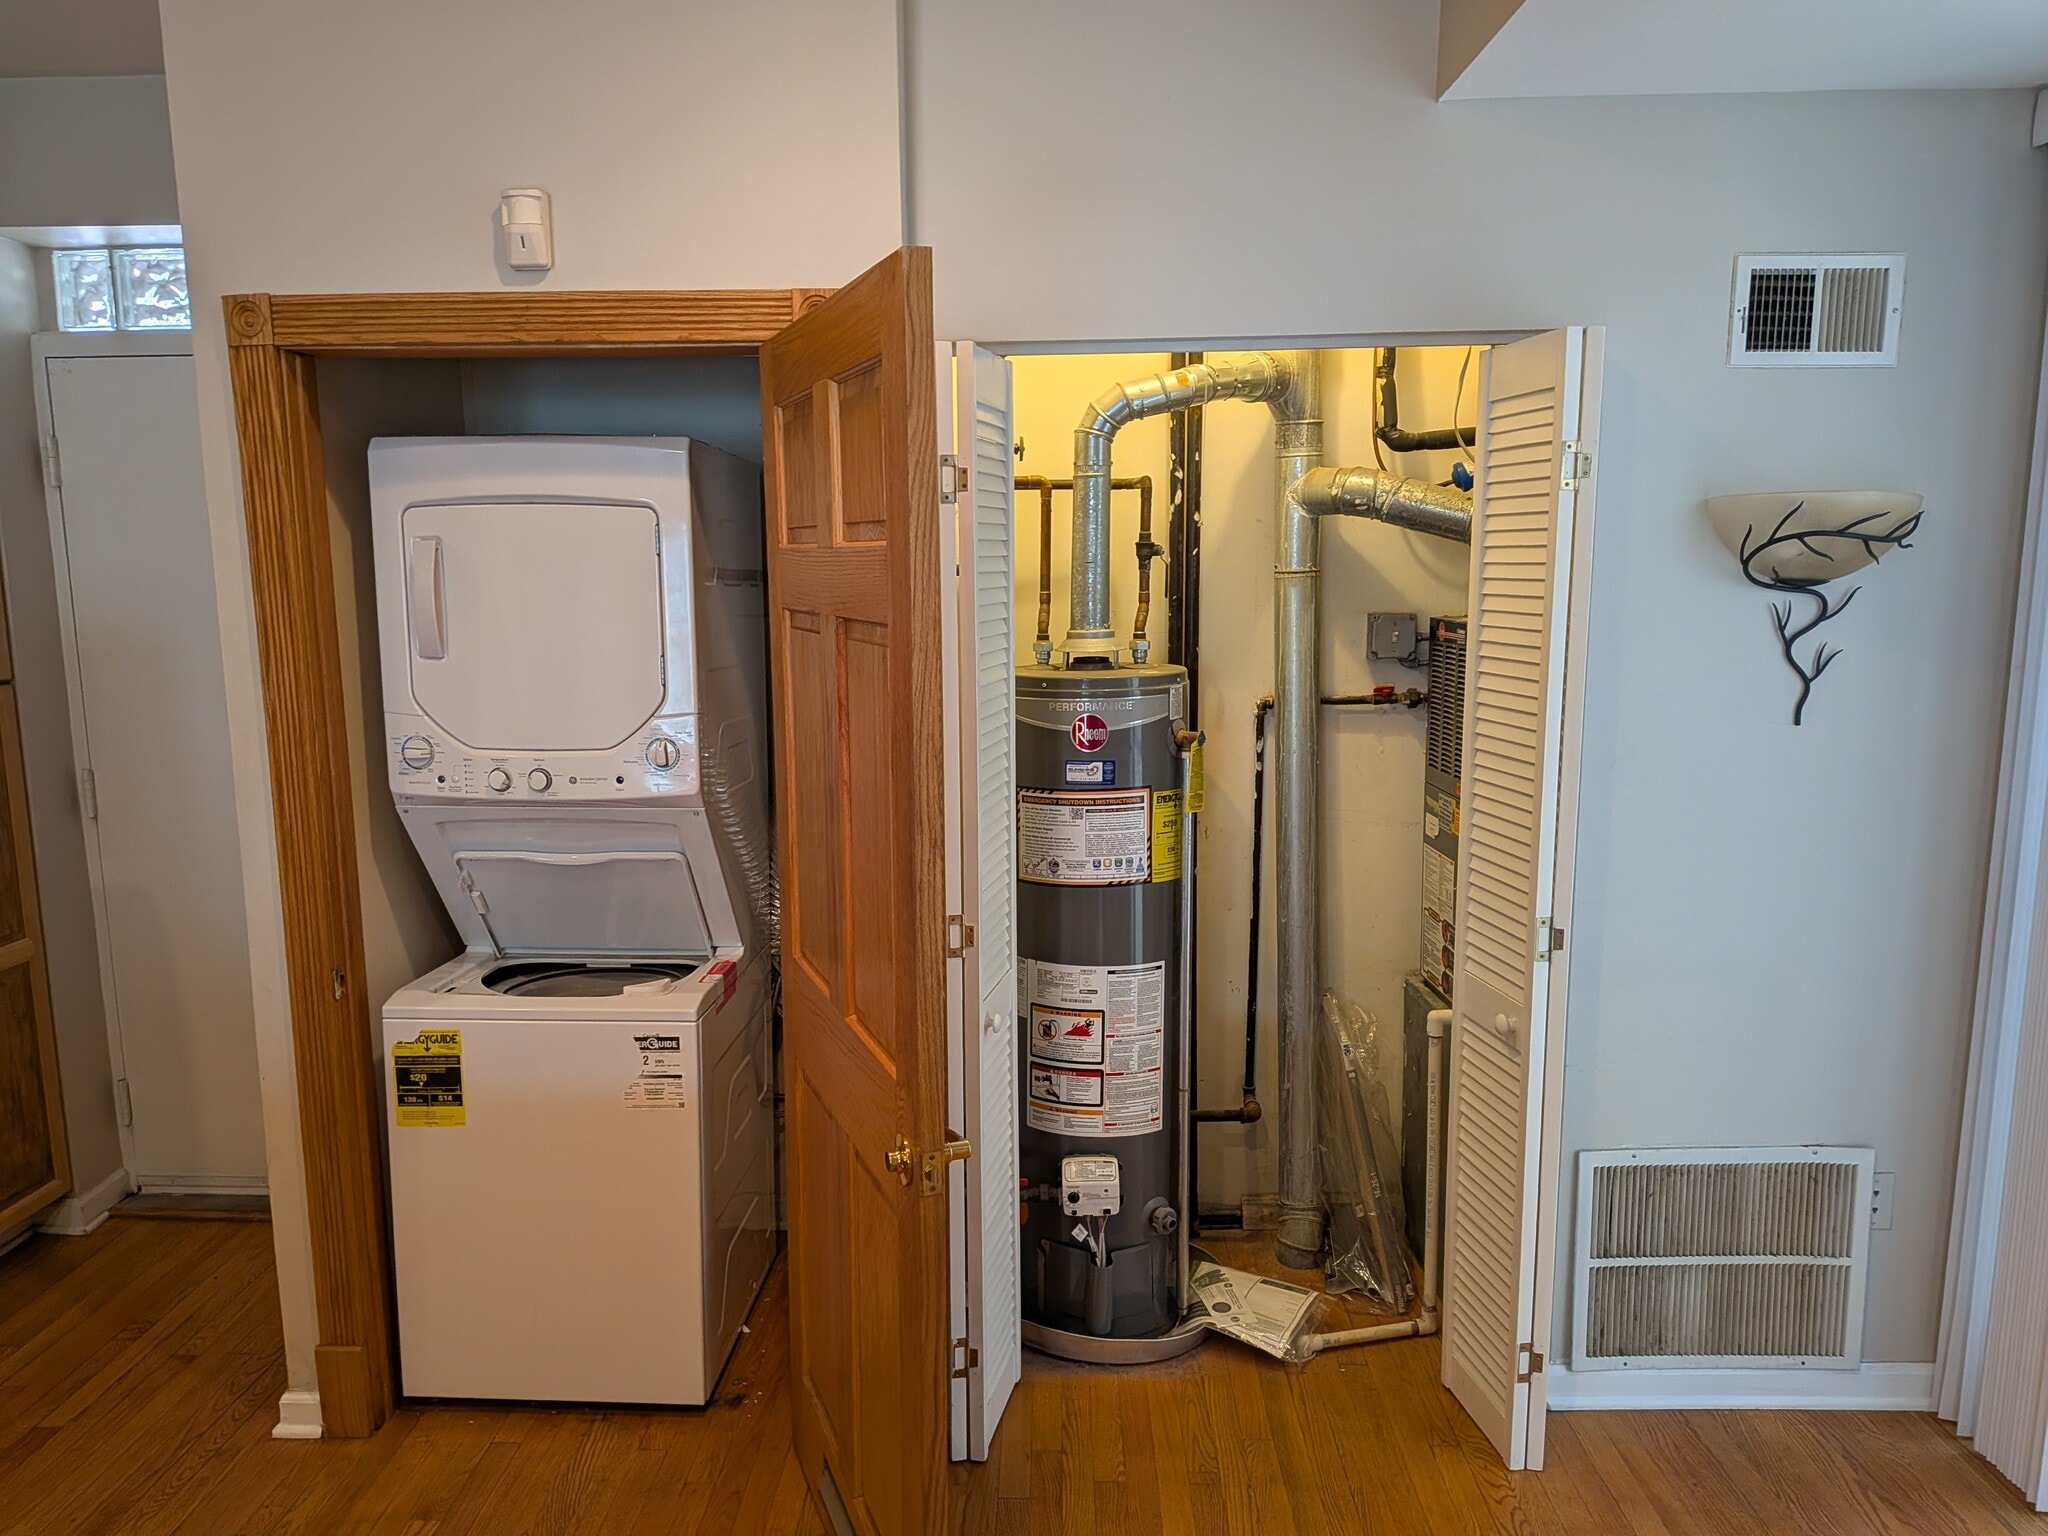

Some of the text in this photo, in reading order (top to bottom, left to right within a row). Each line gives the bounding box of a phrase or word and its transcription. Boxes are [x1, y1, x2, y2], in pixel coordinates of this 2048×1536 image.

[1048, 701, 1133, 711] PERFORMANCE
[1075, 715, 1106, 746] Rheem
[1023, 796, 1057, 804] EMERGENCY
[397, 1034, 458, 1045] GYGUIDE
[410, 1073, 427, 1081] $20
